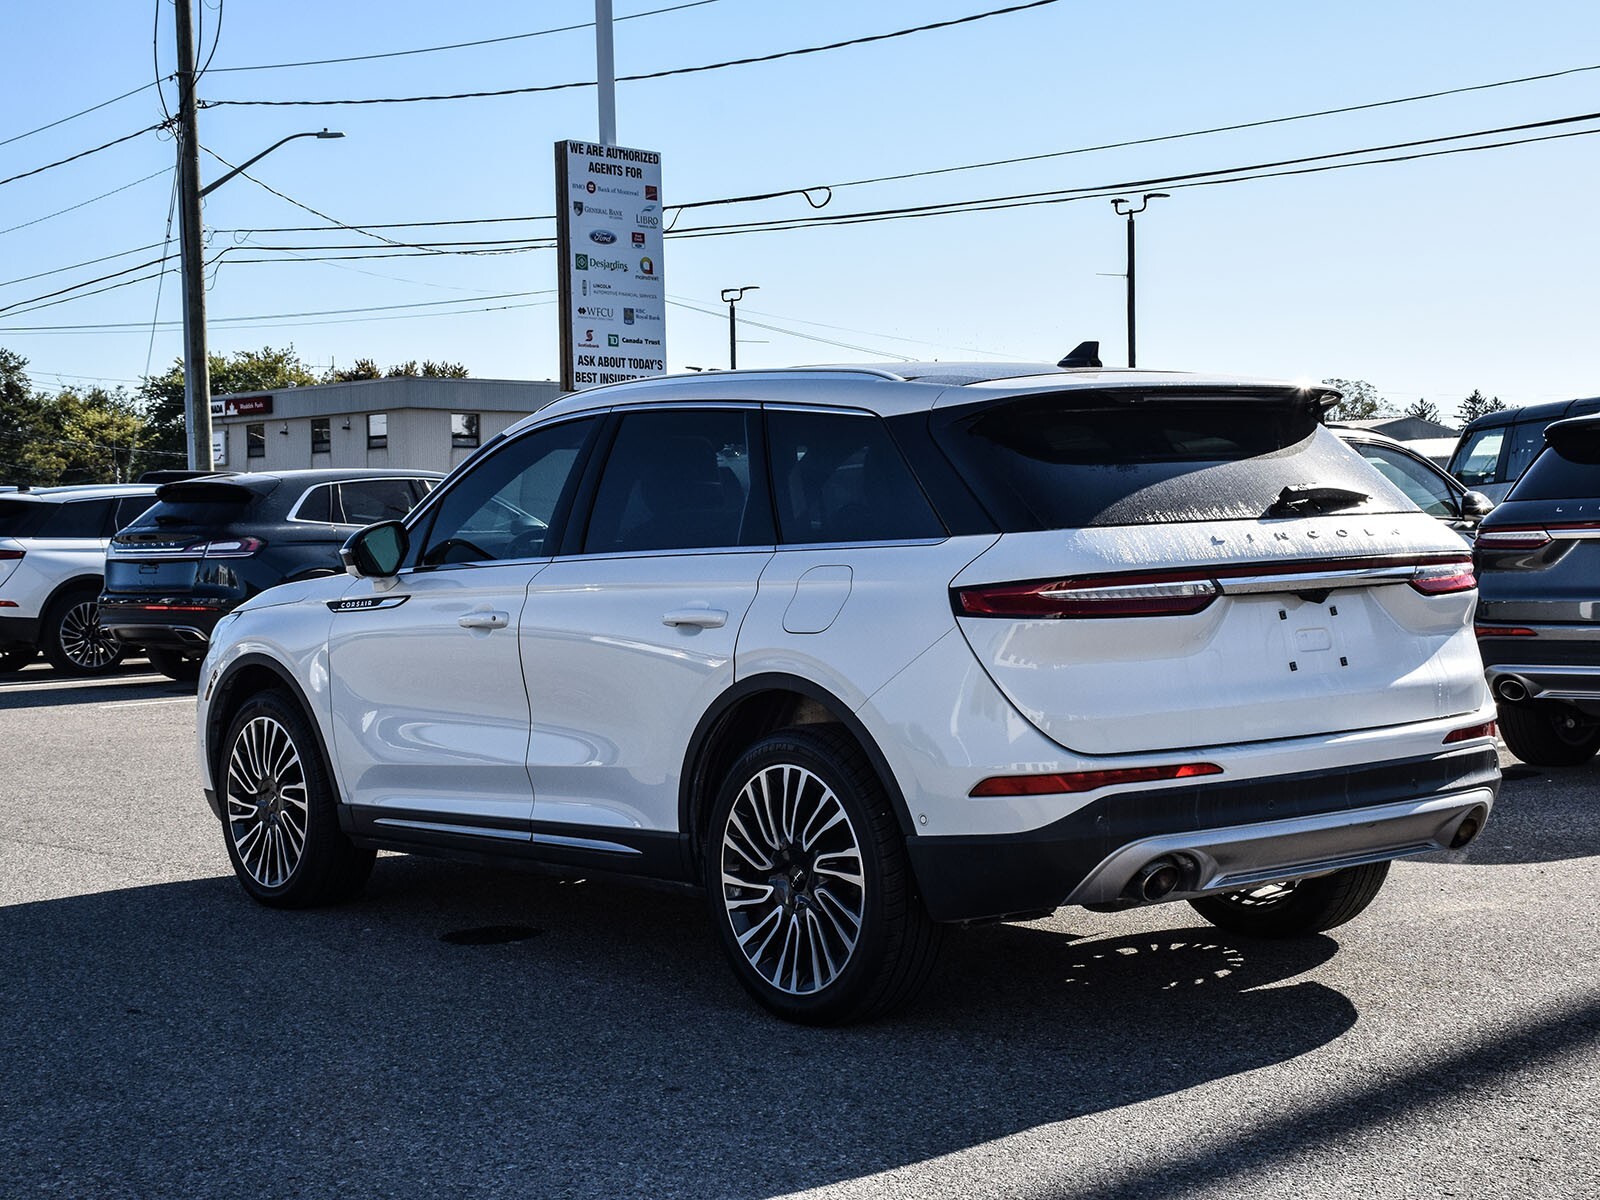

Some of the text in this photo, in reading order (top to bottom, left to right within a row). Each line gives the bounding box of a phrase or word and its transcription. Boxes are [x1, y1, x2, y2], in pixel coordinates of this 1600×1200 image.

[569, 143, 659, 164] WE ARE AUTHORIZED
[588, 162, 642, 178] AGENTS FOR
[617, 188, 640, 196] Montreal
[584, 206, 608, 215] GENERAL
[635, 214, 659, 226] LIBRO
[594, 231, 612, 242] Ford
[589, 258, 628, 271] Desjardins
[587, 306, 614, 317] WFCU
[577, 355, 663, 370] ASK ABOUT TODAY'S
[575, 372, 597, 383] BEST
[1210, 528, 1400, 546] LINCOLN
[340, 600, 372, 608] CORSAIR
